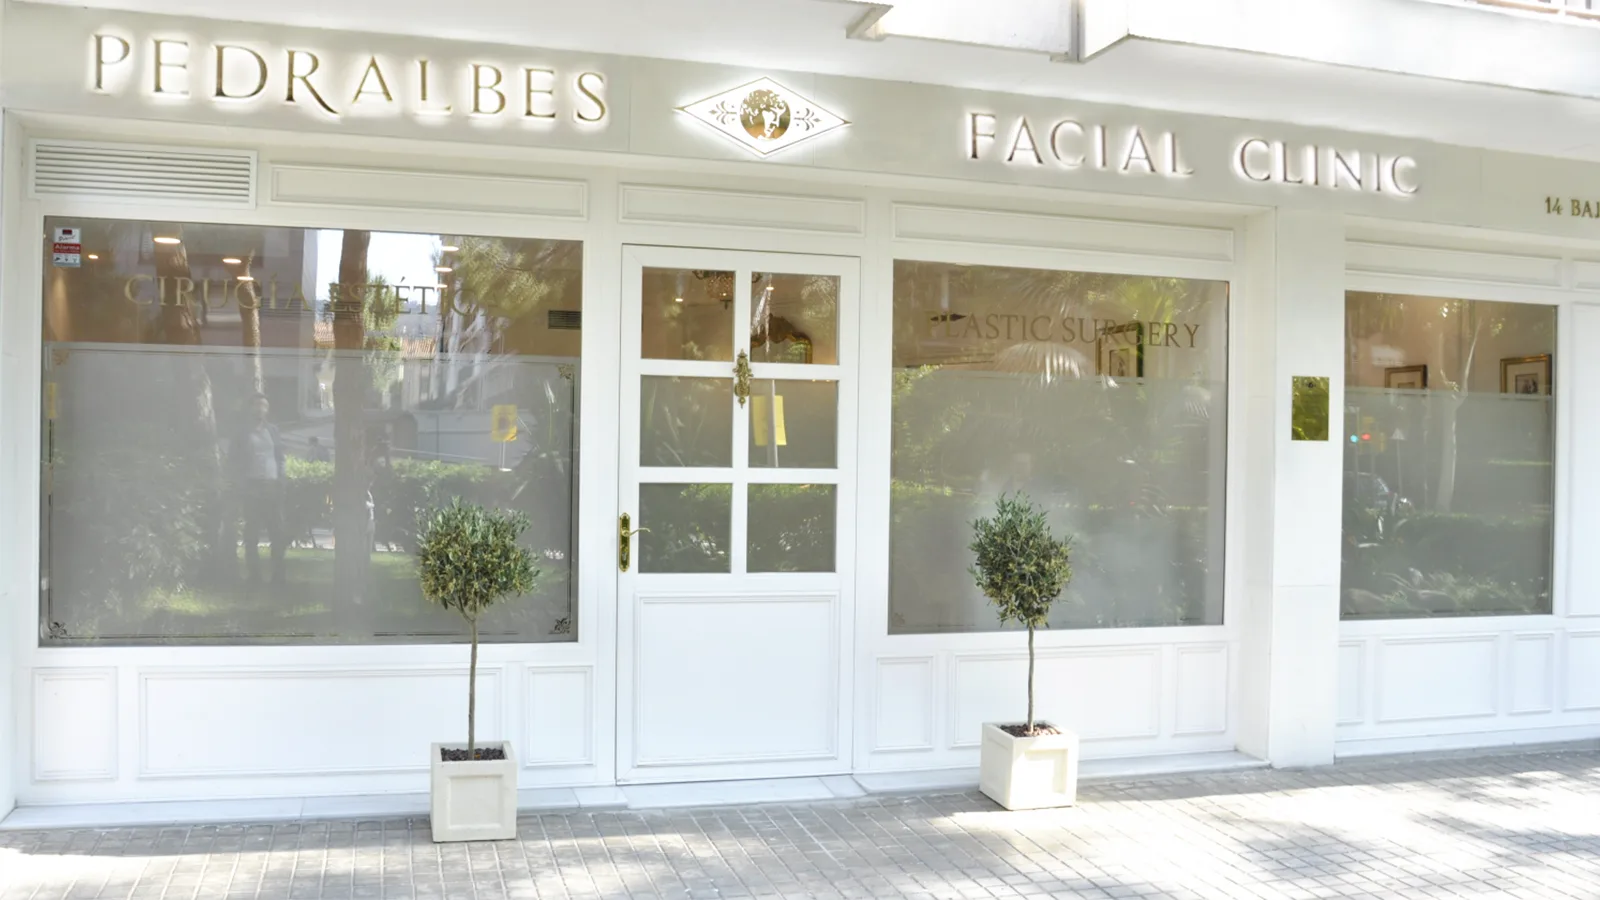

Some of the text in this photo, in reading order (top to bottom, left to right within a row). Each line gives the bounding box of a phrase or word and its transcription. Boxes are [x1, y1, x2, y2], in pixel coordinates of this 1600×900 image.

[93, 33, 608, 122] PEDRALBES
[969, 112, 1419, 194] FACIAL CLINIC
[1545, 196, 1563, 215] 14
[124, 273, 313, 310] CIRUGÍA
[928, 312, 1200, 348] PLASTIC SURGERY
